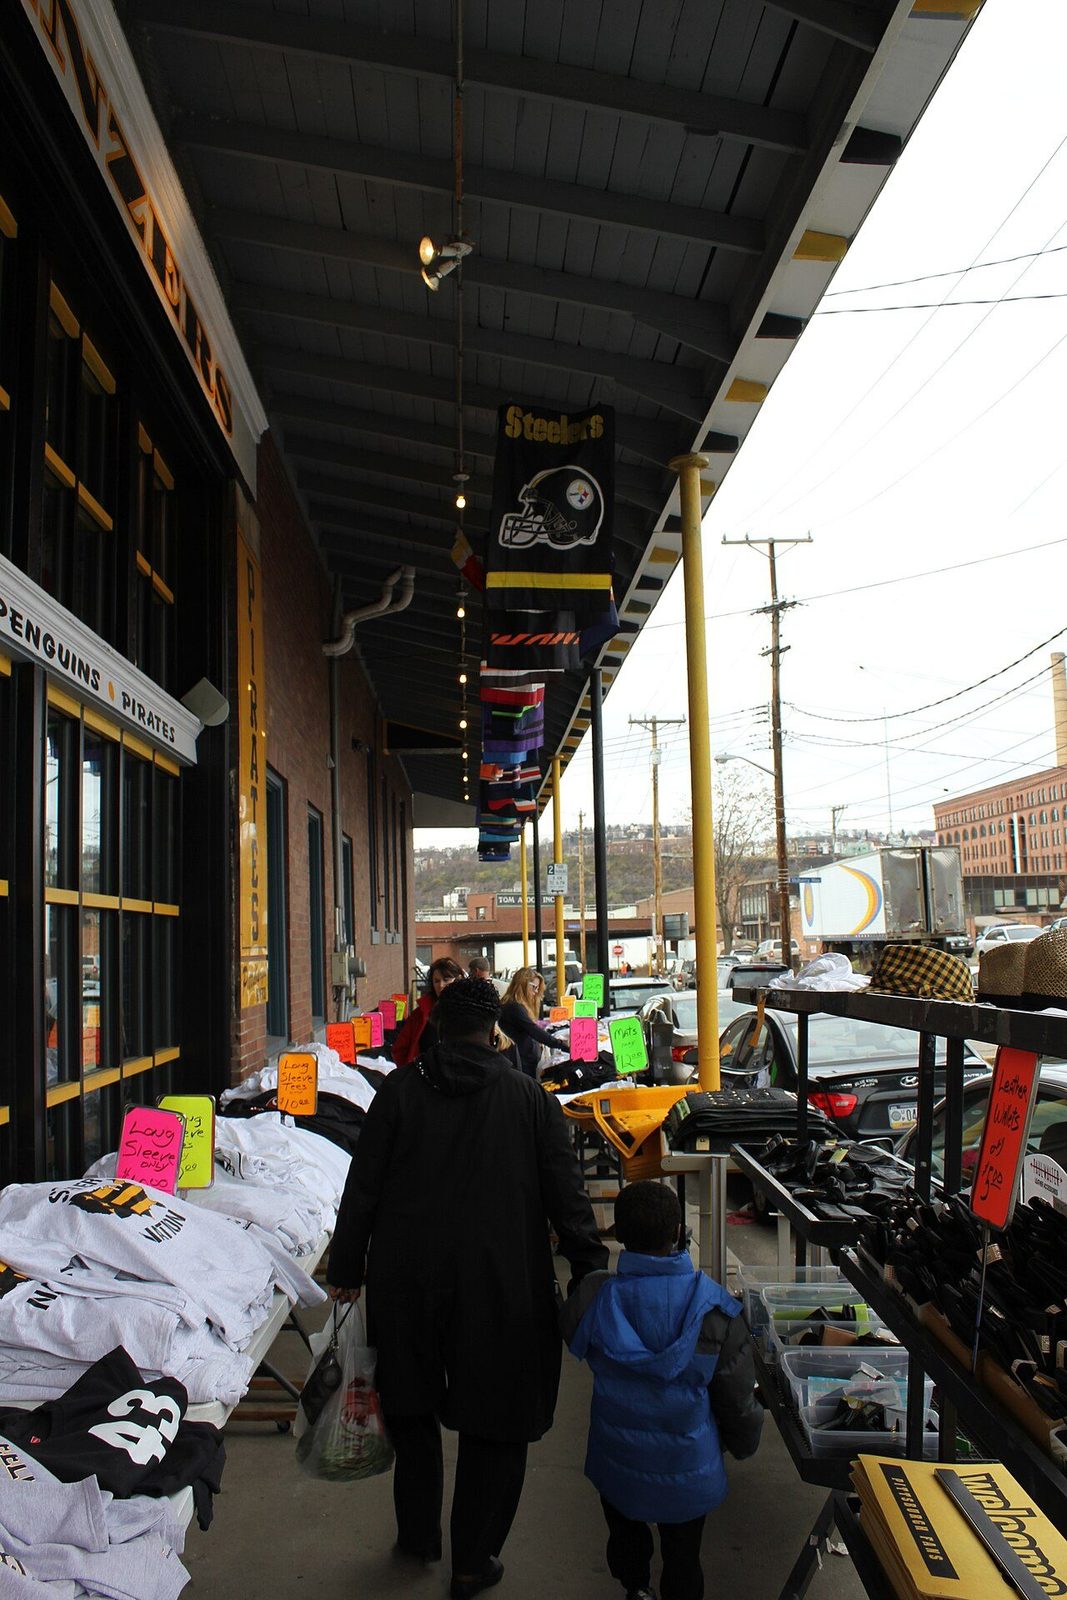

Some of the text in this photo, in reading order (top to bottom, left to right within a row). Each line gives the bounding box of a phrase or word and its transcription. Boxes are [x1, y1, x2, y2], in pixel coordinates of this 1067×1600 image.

[505, 405, 604, 445] Steelers
[0, 597, 176, 743] PENGUINS PIRATES
[247, 560, 260, 941] PIRATES
[498, 896, 515, 904] TOM
[543, 896, 555, 904] INC
[280, 1073, 313, 1083] Sleeve
[284, 1060, 309, 1074] Long
[281, 1083, 307, 1091] Tees
[129, 1121, 175, 1148] Long
[122, 1140, 176, 1165] Sleeve
[139, 1209, 187, 1244] NATION
[88, 1389, 182, 1466] 43
[891, 1475, 943, 1563] PITTSBURGH FANS
